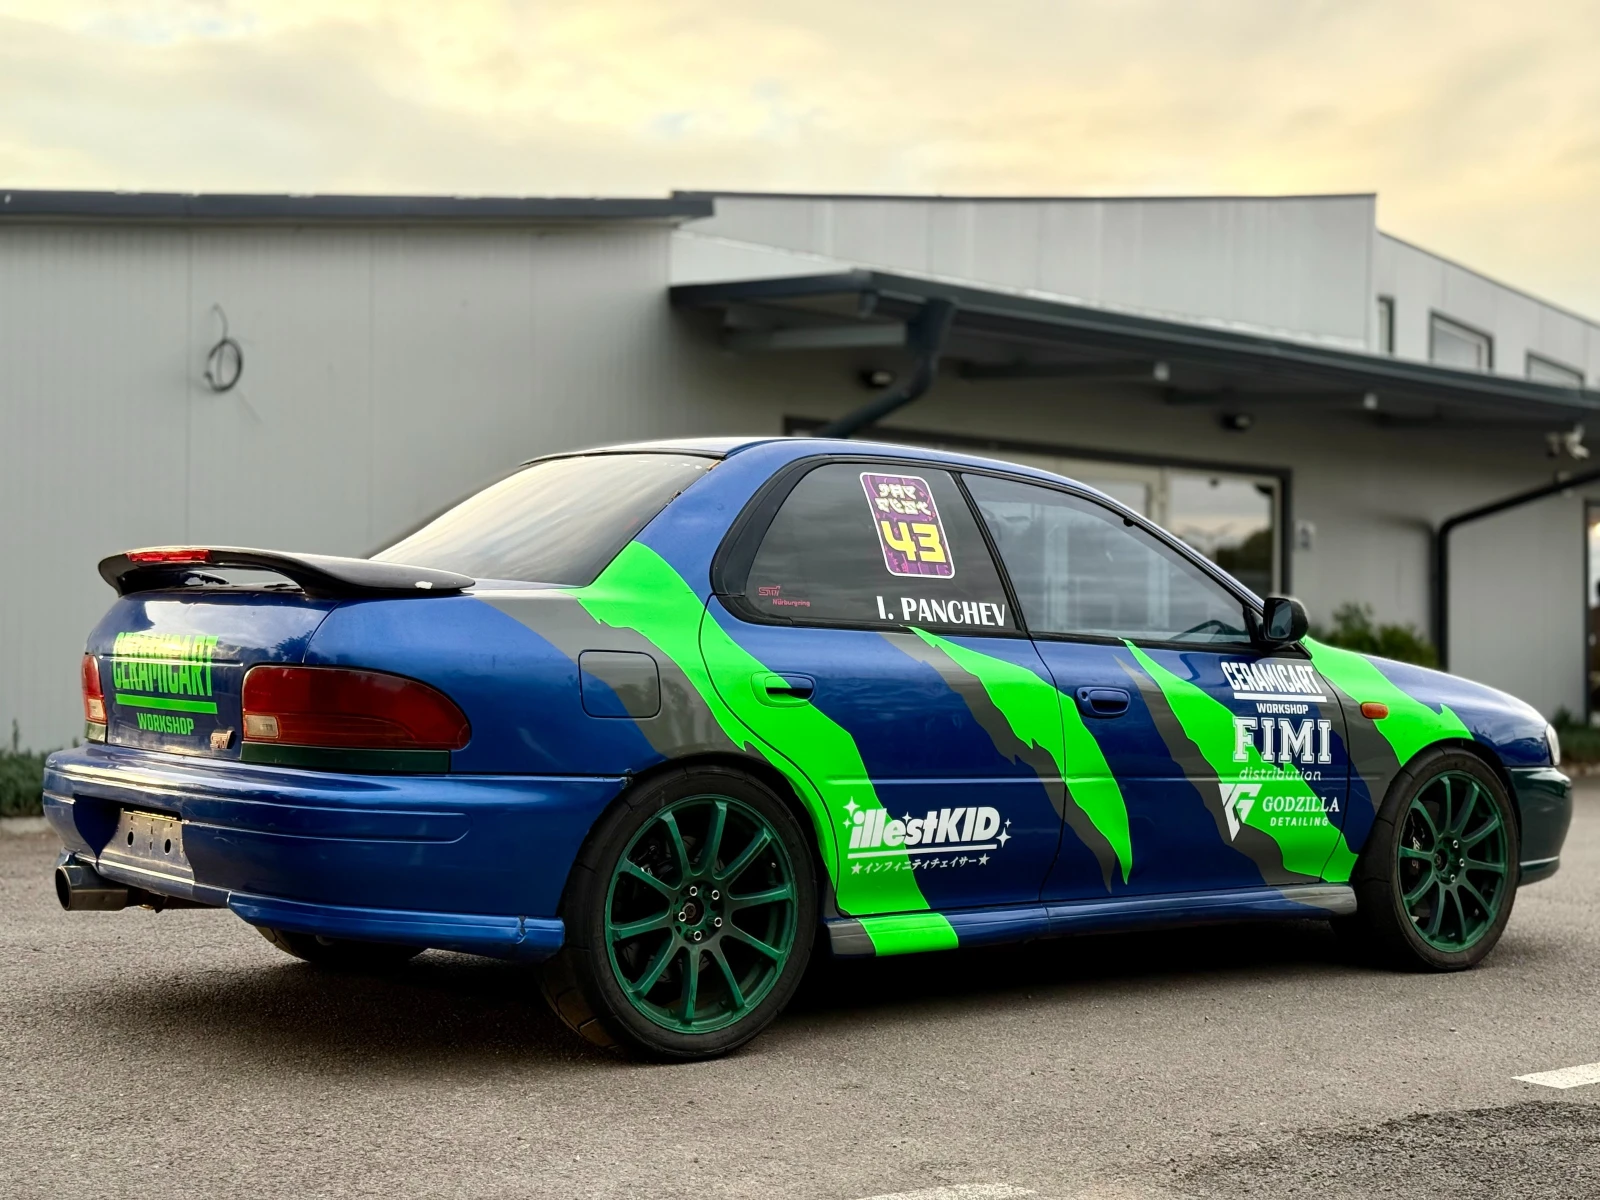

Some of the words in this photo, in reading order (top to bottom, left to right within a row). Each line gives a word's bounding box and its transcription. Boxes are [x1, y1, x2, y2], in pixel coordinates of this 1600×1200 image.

[880, 520, 947, 563] 43
[876, 595, 894, 620] I.
[900, 597, 1006, 627] PANCHEV
[112, 631, 219, 697] CERAMICART
[1220, 661, 1323, 694] CERAMICART
[1256, 702, 1309, 715] WORKSHOP
[136, 712, 195, 736] WORKSHOP
[1232, 716, 1332, 765] FIMI
[1239, 767, 1321, 781] distribution
[1262, 796, 1340, 813] GODZILLA
[1269, 816, 1329, 827] DETAILING
